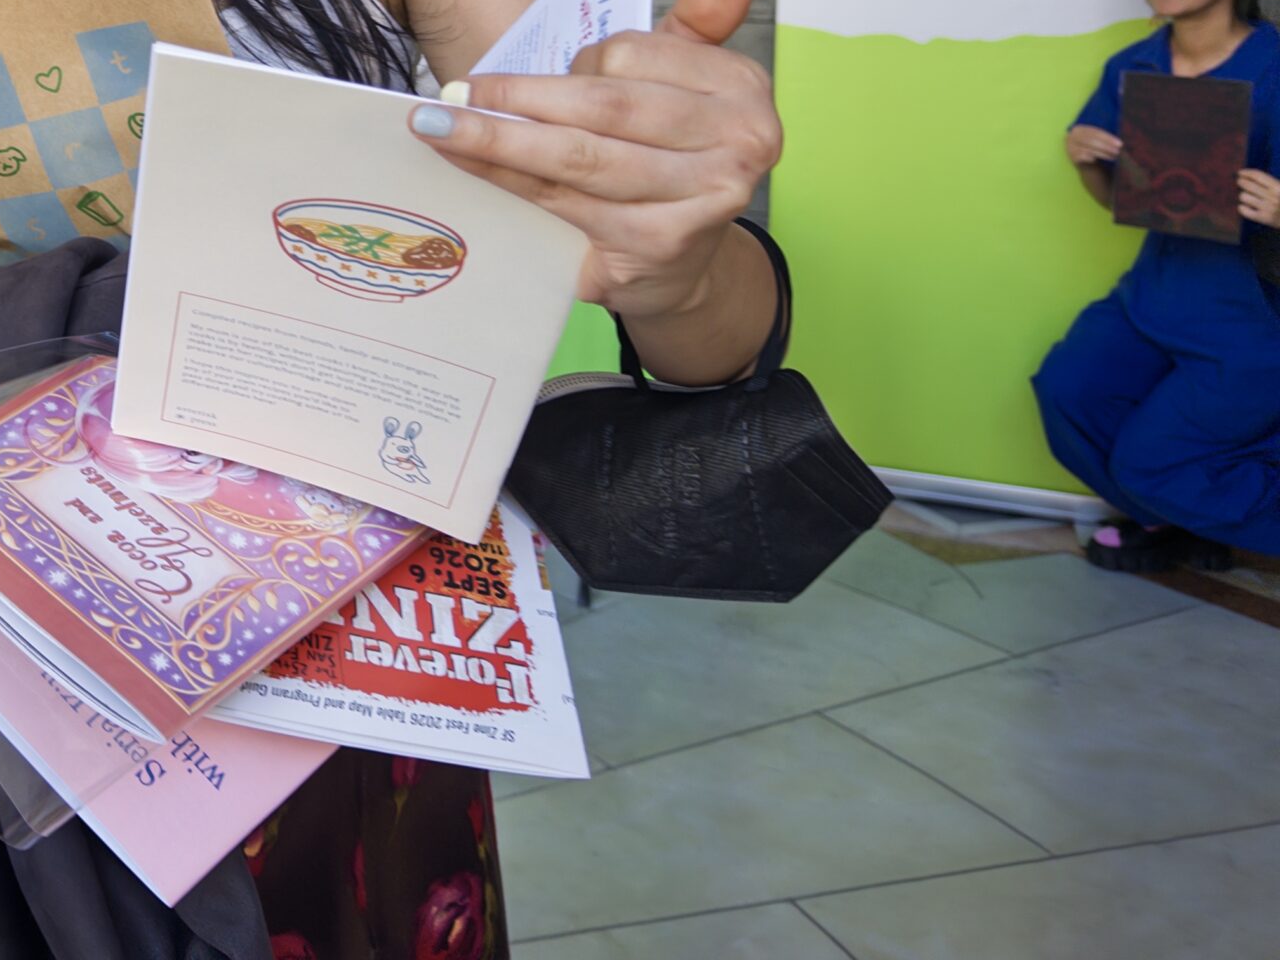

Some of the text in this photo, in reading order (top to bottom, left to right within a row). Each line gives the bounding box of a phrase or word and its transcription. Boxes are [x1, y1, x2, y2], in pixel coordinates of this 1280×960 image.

[274, 328, 297, 338] from
[403, 380, 417, 388] the
[81, 467, 214, 574] Hazelnuts
[64, 498, 194, 605] Cocoa and
[430, 548, 501, 575] 2026
[408, 564, 507, 597] SEPT. 6
[322, 581, 526, 661] ZIN
[305, 649, 335, 665] SAN
[343, 634, 537, 705] Forever
[270, 686, 321, 706] Program
[323, 697, 345, 711] and
[348, 699, 373, 716] Map
[375, 706, 407, 722] Table
[409, 712, 441, 728] 2026
[443, 718, 469, 733] Fest
[471, 723, 498, 739] Zine
[499, 728, 515, 741] SF
[170, 732, 226, 790] with
